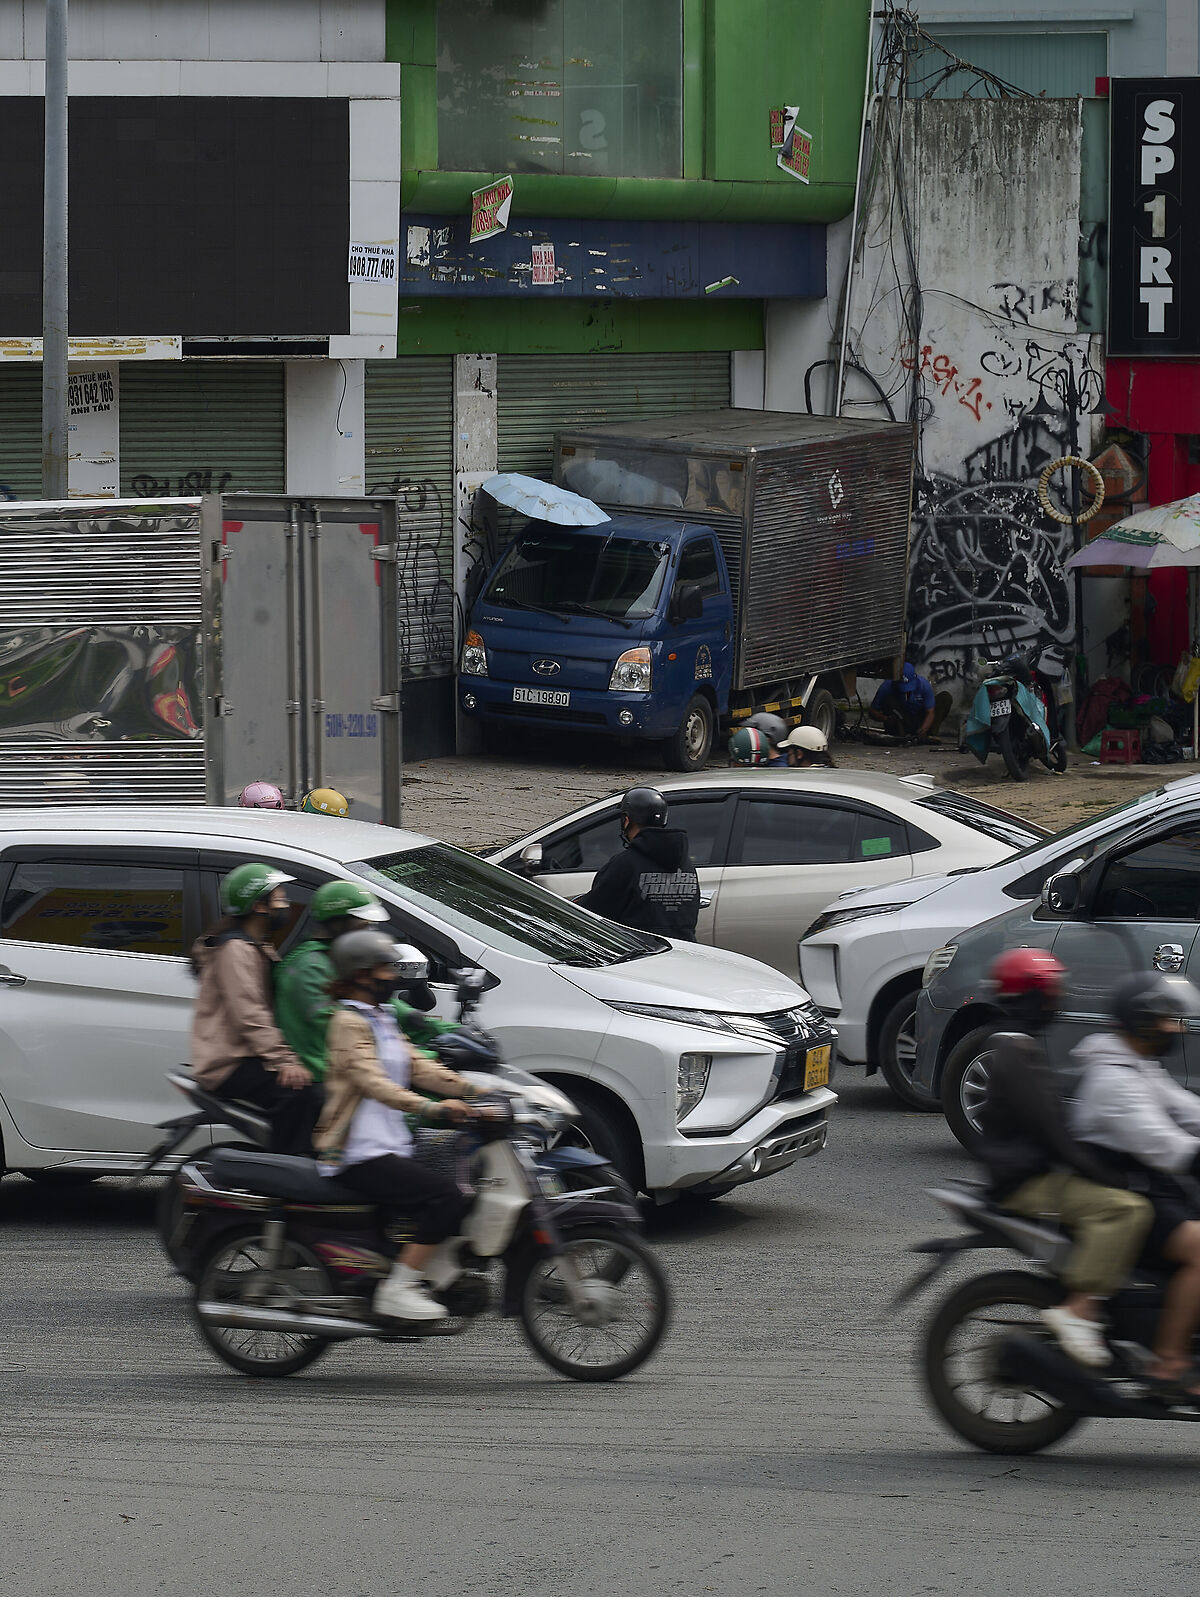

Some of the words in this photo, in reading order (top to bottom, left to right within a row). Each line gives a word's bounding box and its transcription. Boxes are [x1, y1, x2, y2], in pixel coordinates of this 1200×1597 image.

[364, 246, 381, 255] THUÊ
[381, 247, 395, 256] NHÀ
[78, 371, 97, 384] THUÊ
[97, 370, 112, 382] NHÀ
[83, 382, 99, 406] 642
[99, 380, 114, 404] 166
[70, 406, 90, 416] ANH
[514, 689, 568, 706] 51C-198.90
